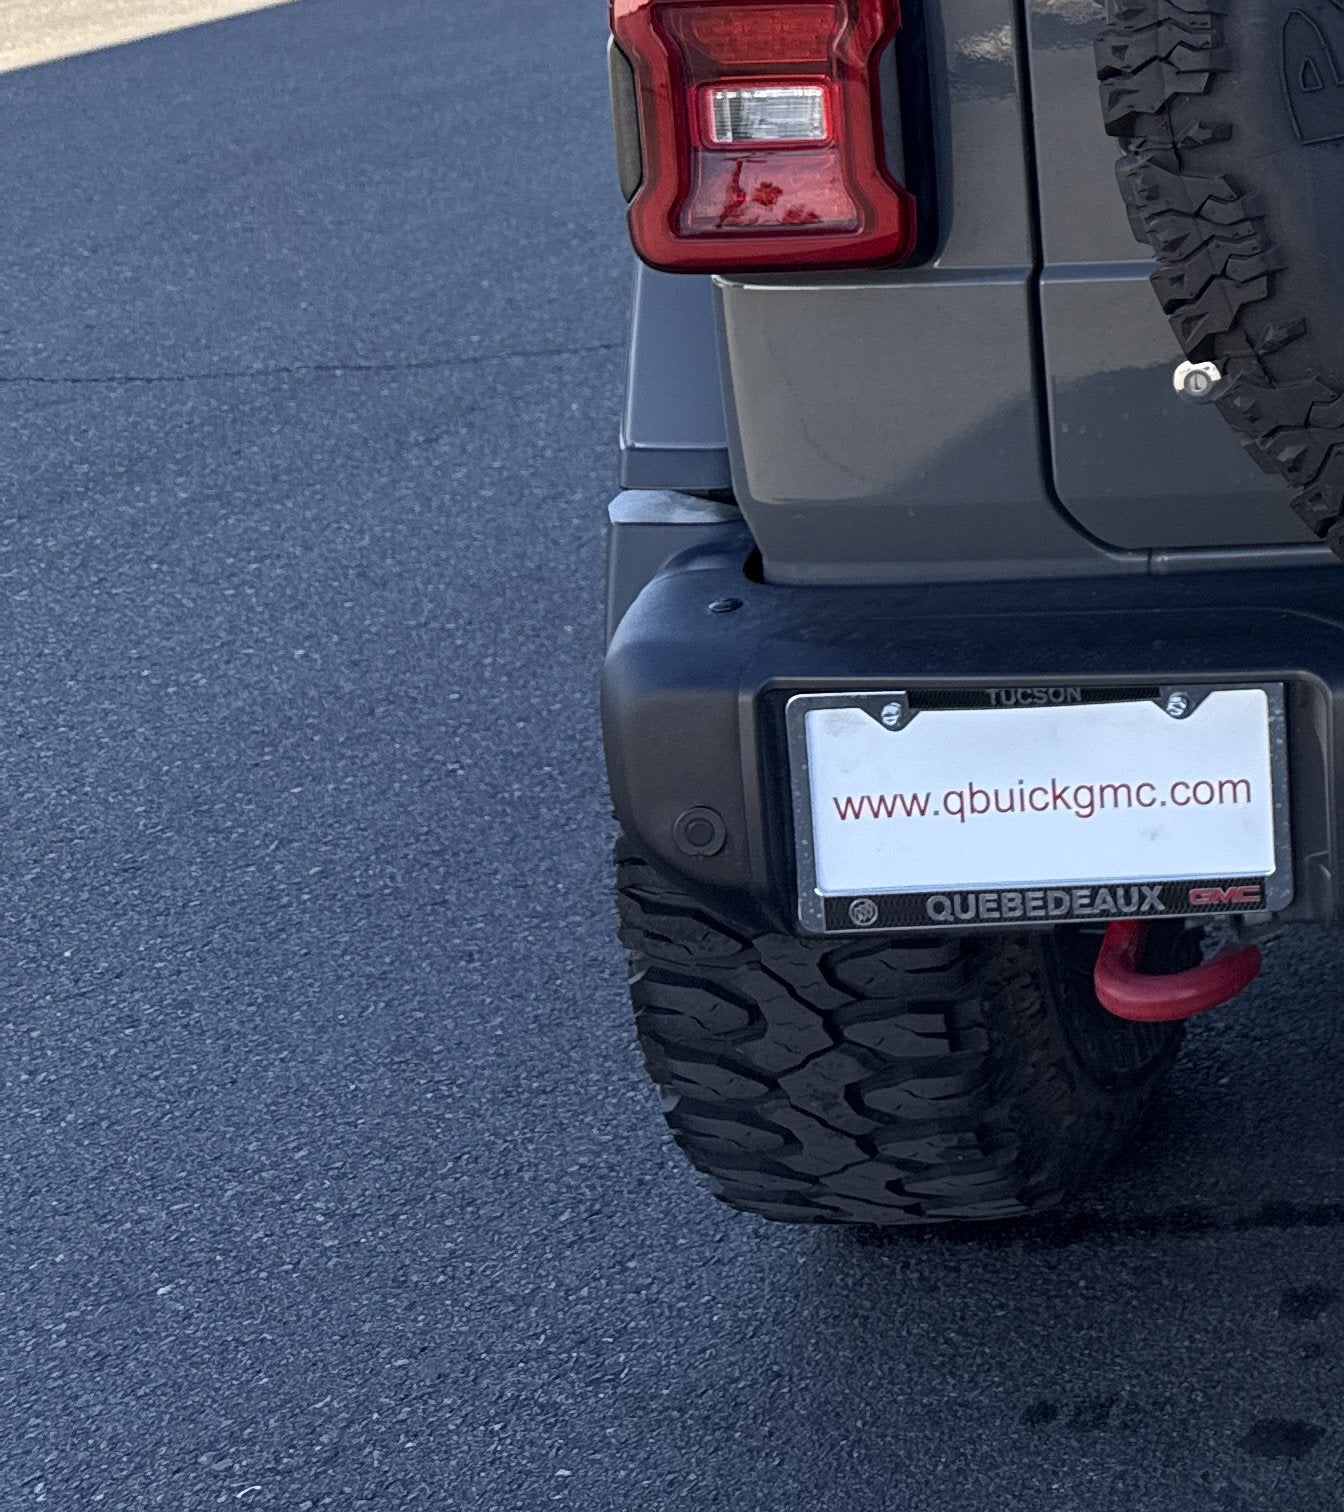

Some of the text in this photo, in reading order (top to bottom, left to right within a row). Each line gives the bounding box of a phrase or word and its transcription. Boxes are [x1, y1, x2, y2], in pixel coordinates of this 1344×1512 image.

[985, 686, 1082, 706] TUCSON
[832, 776, 1252, 823] www.qbuickgmc.com
[925, 884, 1262, 923] QUEBEDEAUX GMC
